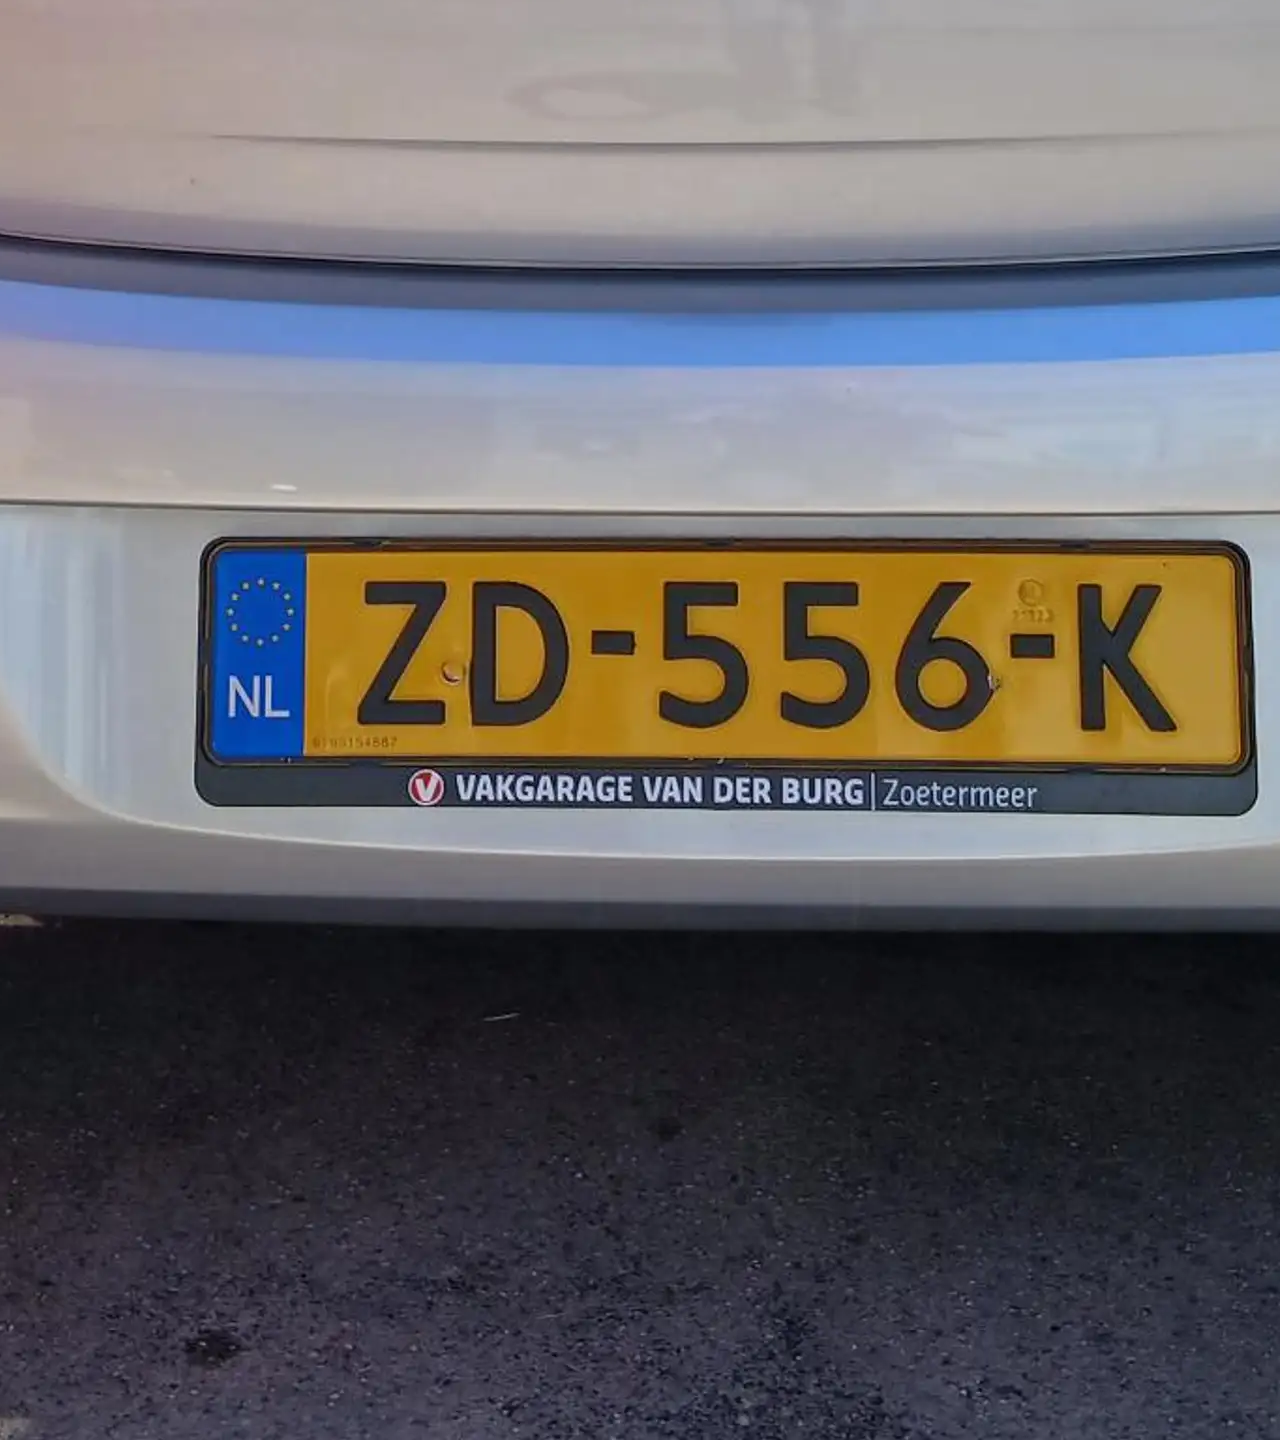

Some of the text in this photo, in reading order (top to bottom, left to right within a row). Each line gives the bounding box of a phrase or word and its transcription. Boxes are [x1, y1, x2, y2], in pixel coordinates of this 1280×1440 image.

[357, 580, 1178, 732] ZD-556-K
[228, 675, 290, 718] NL
[456, 773, 633, 803] VAKGARAGE
[642, 775, 703, 804] VAN
[713, 776, 772, 805] DER
[782, 777, 864, 806] BURG
[883, 778, 1038, 808] Zoetermeer
